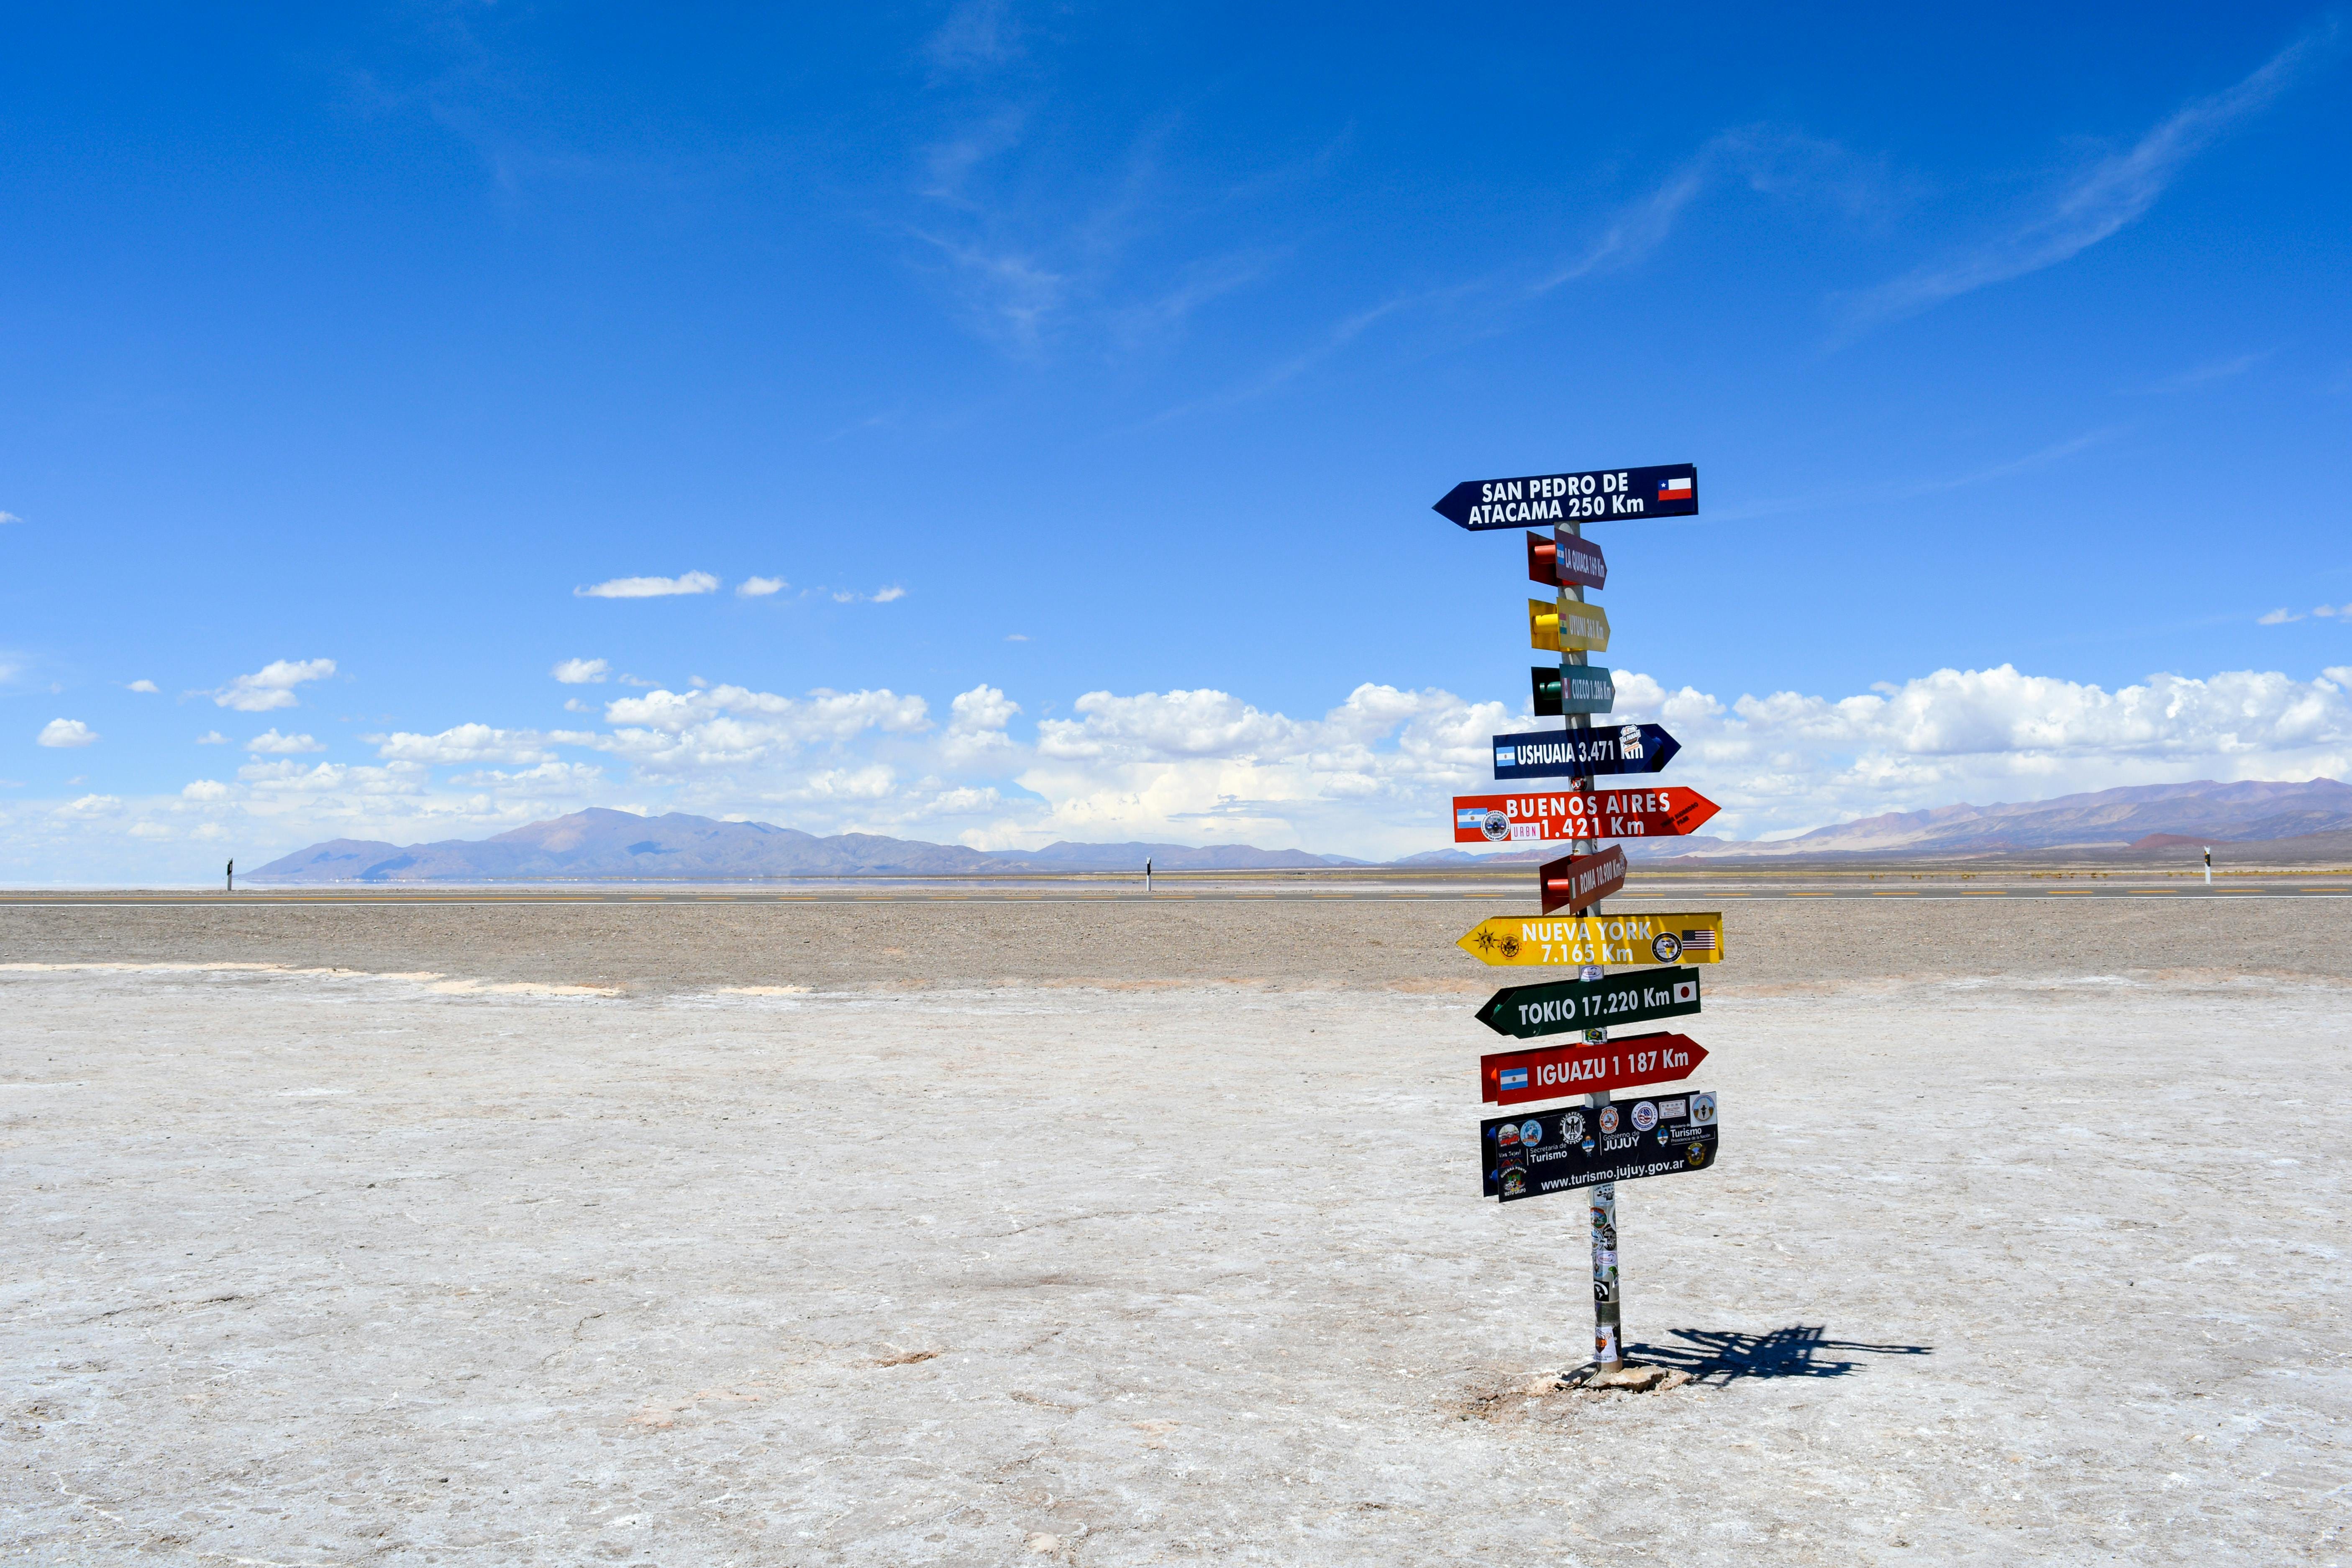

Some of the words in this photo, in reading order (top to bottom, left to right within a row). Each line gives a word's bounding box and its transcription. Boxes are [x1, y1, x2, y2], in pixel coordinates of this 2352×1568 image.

[1482, 482, 1522, 502] SAN
[1530, 475, 1596, 499] PEDRO
[1604, 472, 1628, 492] DE
[1468, 500, 1563, 525] ATACAMA
[1569, 497, 1604, 517] 250
[1612, 496, 1644, 514] Km
[1565, 548, 1572, 569] LA
[1572, 550, 1589, 574] QUIACA
[1597, 558, 1605, 578] Km
[1569, 614, 1586, 637] UYUNI
[1596, 620, 1604, 640] Km
[1572, 679, 1590, 699] CUZCO
[1590, 680, 1603, 700] 1.286
[1603, 681, 1611, 700] Km
[1517, 742, 1576, 765] USHUAIA
[1578, 740, 1614, 762] 3.471
[1507, 796, 1598, 817] BUENOS
[1606, 792, 1670, 815] AIRES
[1514, 826, 1536, 837] URBN
[1541, 817, 1599, 837] 1.421
[1611, 816, 1645, 835] Km
[1580, 869, 1596, 894] ROMA
[1596, 861, 1613, 886] 10.900
[1613, 859, 1620, 878] Km
[1522, 922, 1590, 942] NUEVA
[1595, 921, 1652, 940] YORK
[1541, 944, 1595, 963] 7.165
[1601, 945, 1633, 962] Km
[1518, 998, 1576, 1025] TOKIO
[1582, 990, 1639, 1016] 17.220
[1644, 986, 1670, 1008] Km
[1537, 1057, 1606, 1086] IGUAZU
[1612, 1056, 1619, 1076] 1
[1627, 1050, 1657, 1074] 187
[1663, 1048, 1689, 1069] Km
[1563, 1135, 1583, 1144] TATTOO
[1603, 1132, 1630, 1141] Gobierno
[1604, 1136, 1640, 1151] JUJUY
[1670, 1128, 1702, 1138] Turismo
[1530, 1144, 1558, 1154] Secretaría
[1530, 1150, 1568, 1163] Turismo
[1541, 1159, 1685, 1191] www.turismo.jujuy.gov.ar
